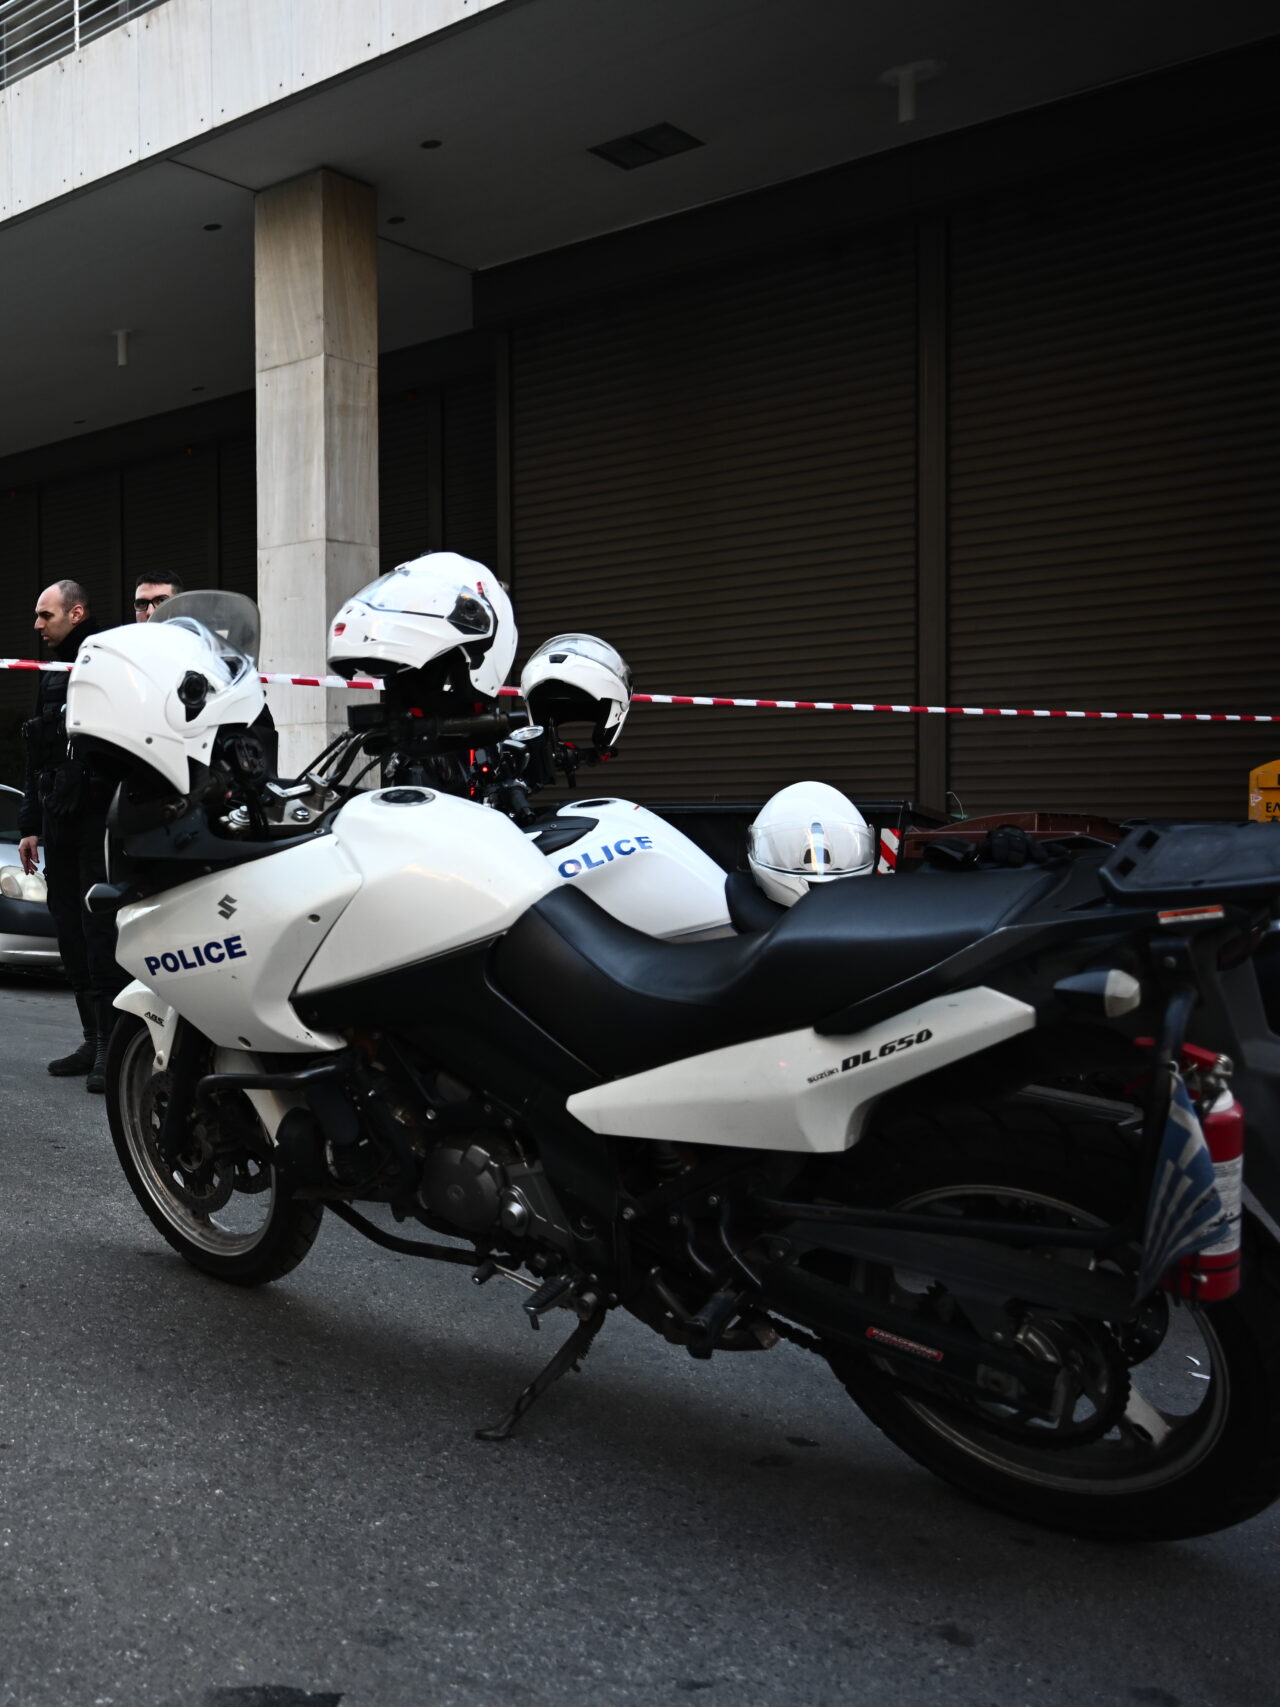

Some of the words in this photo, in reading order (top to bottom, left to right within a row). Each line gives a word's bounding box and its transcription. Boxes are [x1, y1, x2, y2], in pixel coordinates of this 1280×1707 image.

[557, 836, 654, 879] OLICE
[143, 934, 248, 977] POLICE
[806, 1067, 840, 1084] SUZUKI
[841, 1028, 934, 1073] DL650
